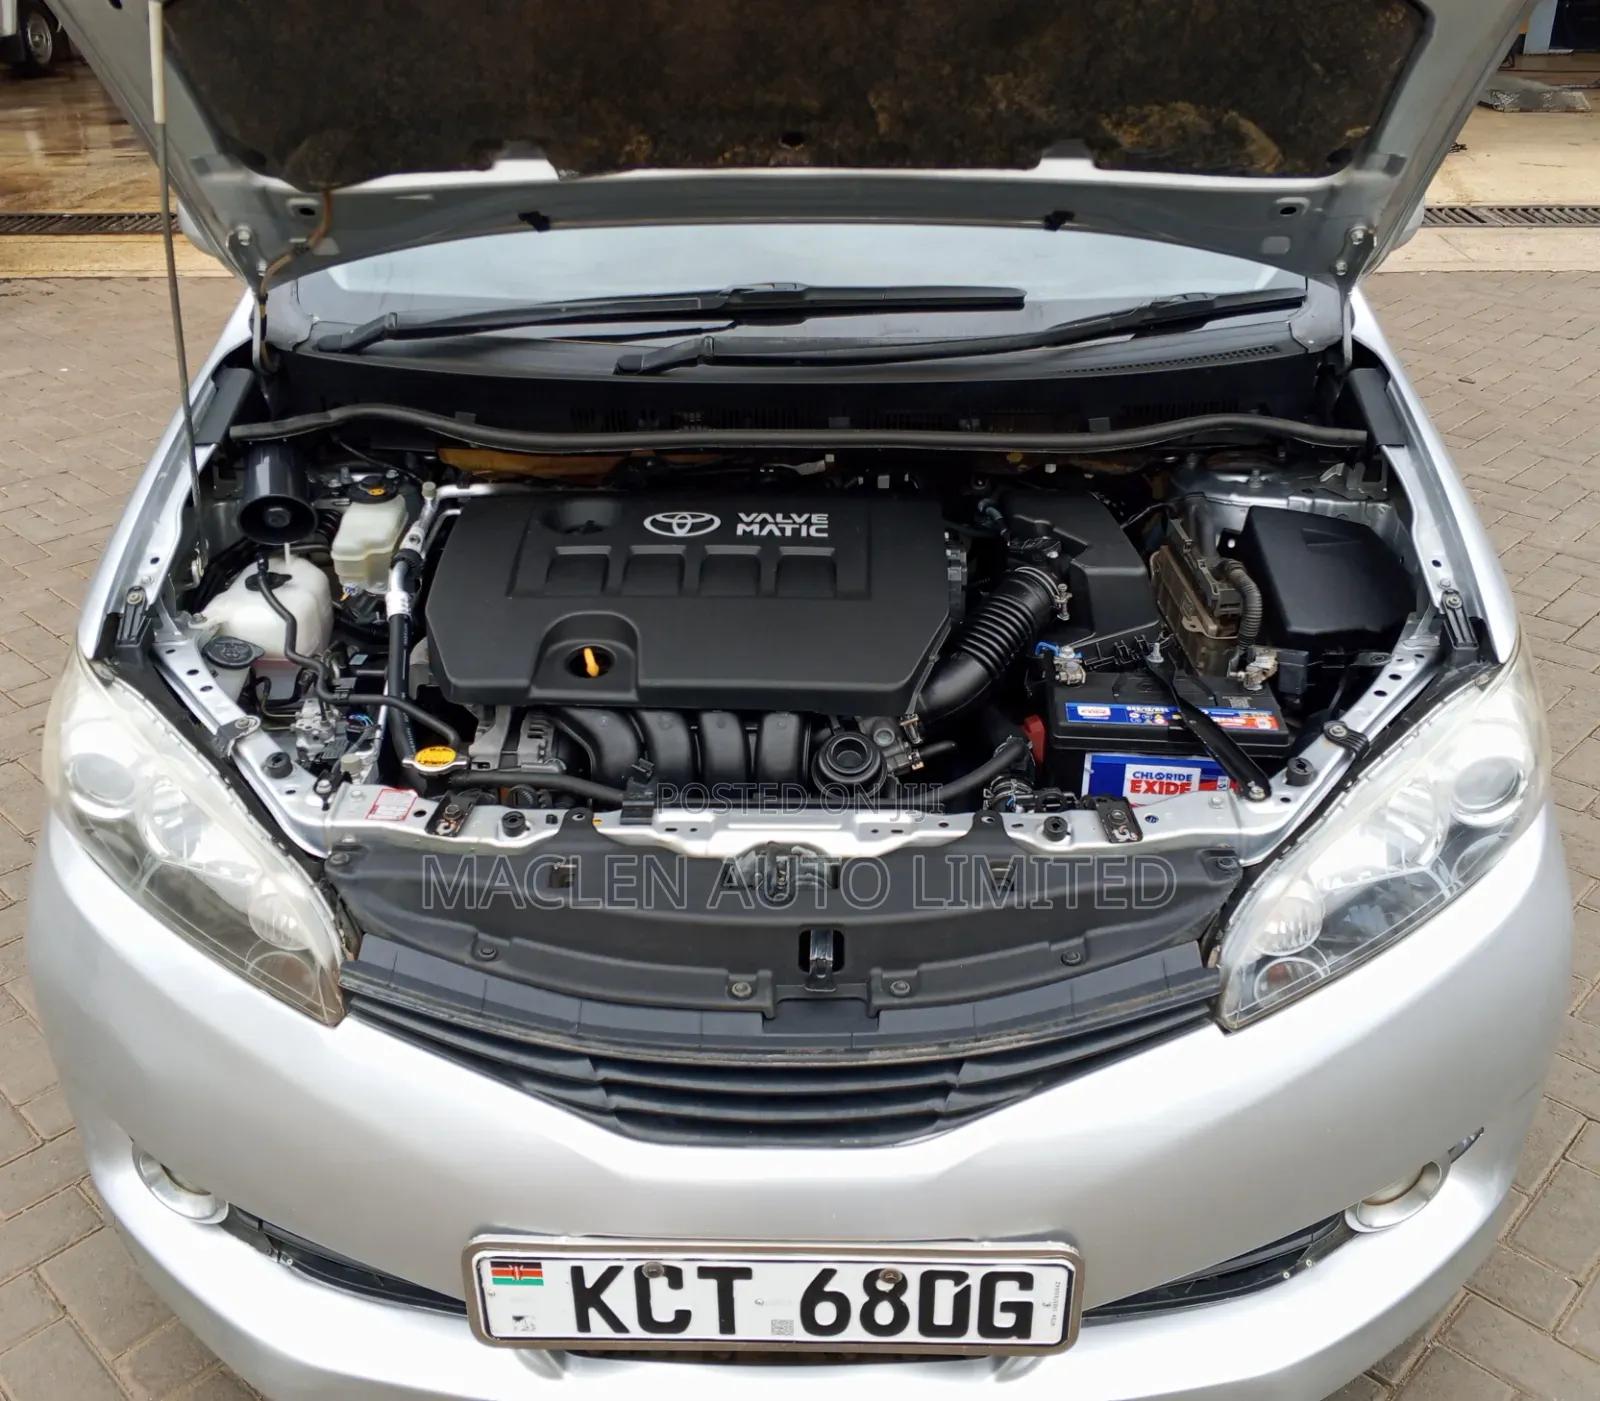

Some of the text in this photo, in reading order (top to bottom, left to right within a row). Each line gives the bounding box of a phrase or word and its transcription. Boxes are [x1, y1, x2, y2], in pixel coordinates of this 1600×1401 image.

[737, 512, 829, 523] VALVE
[736, 523, 829, 537] MATIC
[1132, 771, 1193, 781] CHLORIDE
[1130, 779, 1192, 795] EXIDE
[570, 1264, 752, 1335] KCT
[800, 1267, 1034, 1340] 680G
